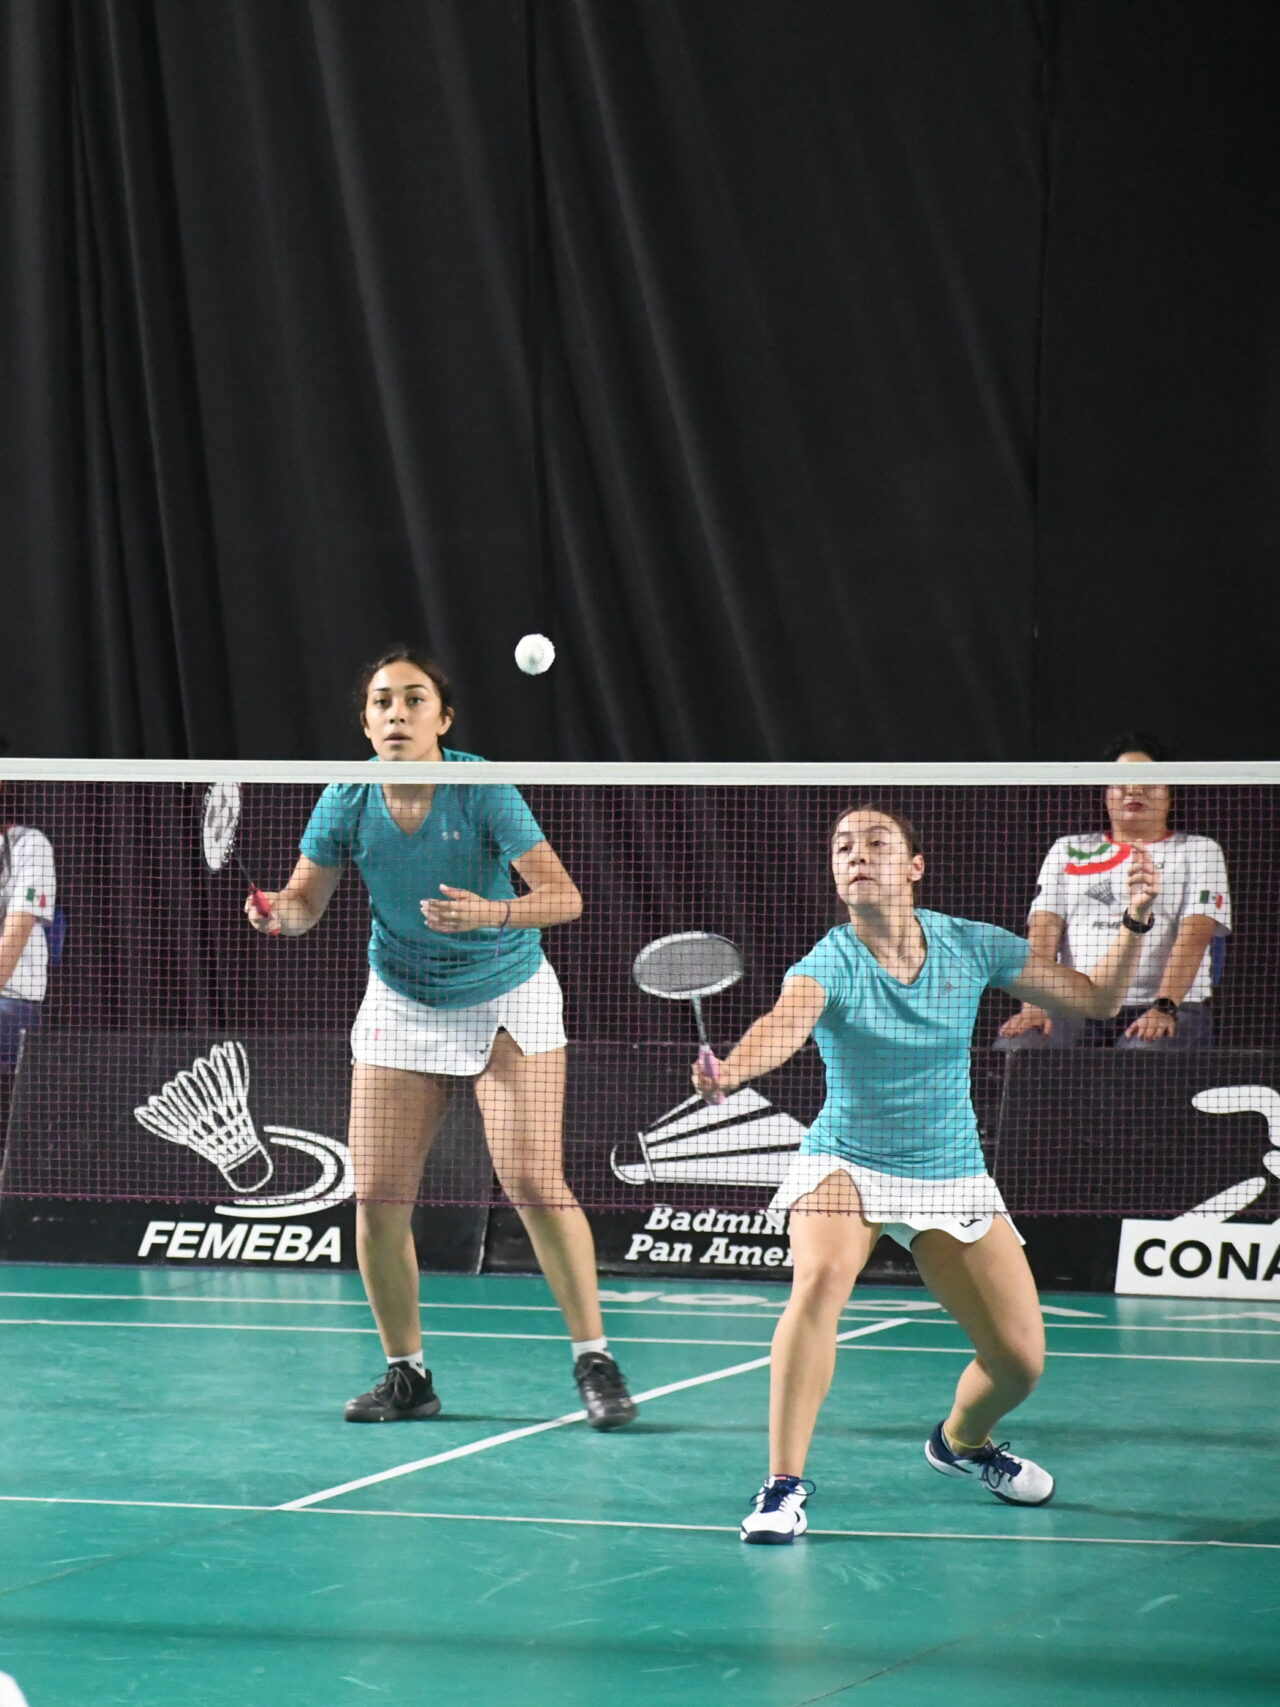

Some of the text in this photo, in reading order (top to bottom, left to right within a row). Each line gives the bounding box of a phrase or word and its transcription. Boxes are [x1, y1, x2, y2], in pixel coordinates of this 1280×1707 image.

[644, 1204, 791, 1236] Badmin
[137, 1221, 341, 1263] FEMEBA
[624, 1234, 693, 1262] Pan
